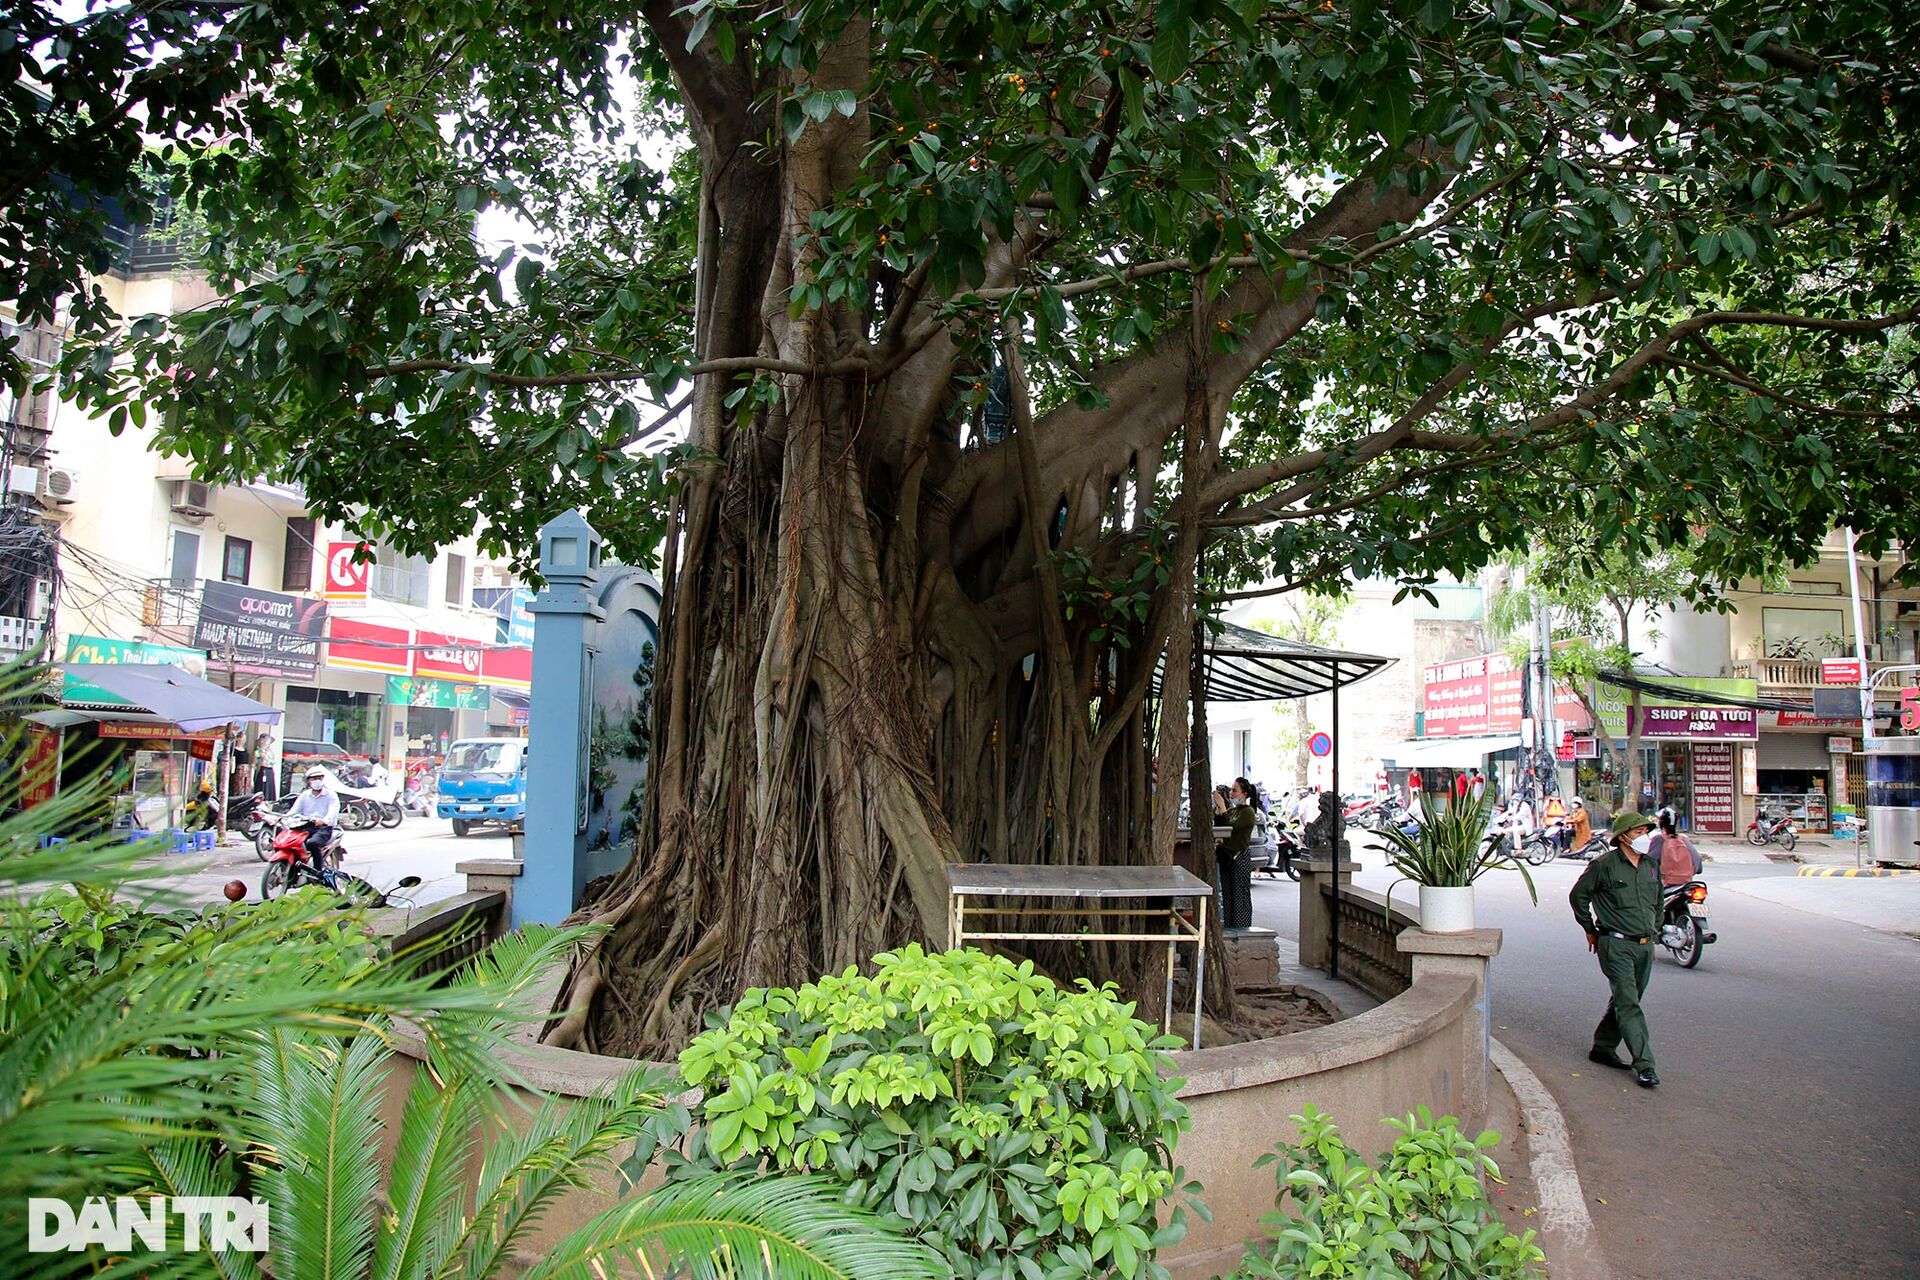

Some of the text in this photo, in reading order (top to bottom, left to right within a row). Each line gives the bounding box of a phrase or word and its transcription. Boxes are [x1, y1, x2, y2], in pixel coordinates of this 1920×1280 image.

[201, 622, 227, 644] MADE
[237, 627, 274, 650] VIETNAM
[122, 648, 142, 664] Thái
[1901, 687, 1920, 730] 5
[1651, 710, 1688, 721] SHOP
[1691, 710, 1718, 721] HOA
[1720, 710, 1752, 722] TƯƠI
[1688, 721, 1716, 732] ROSA
[1709, 786, 1731, 794] FLOWER
